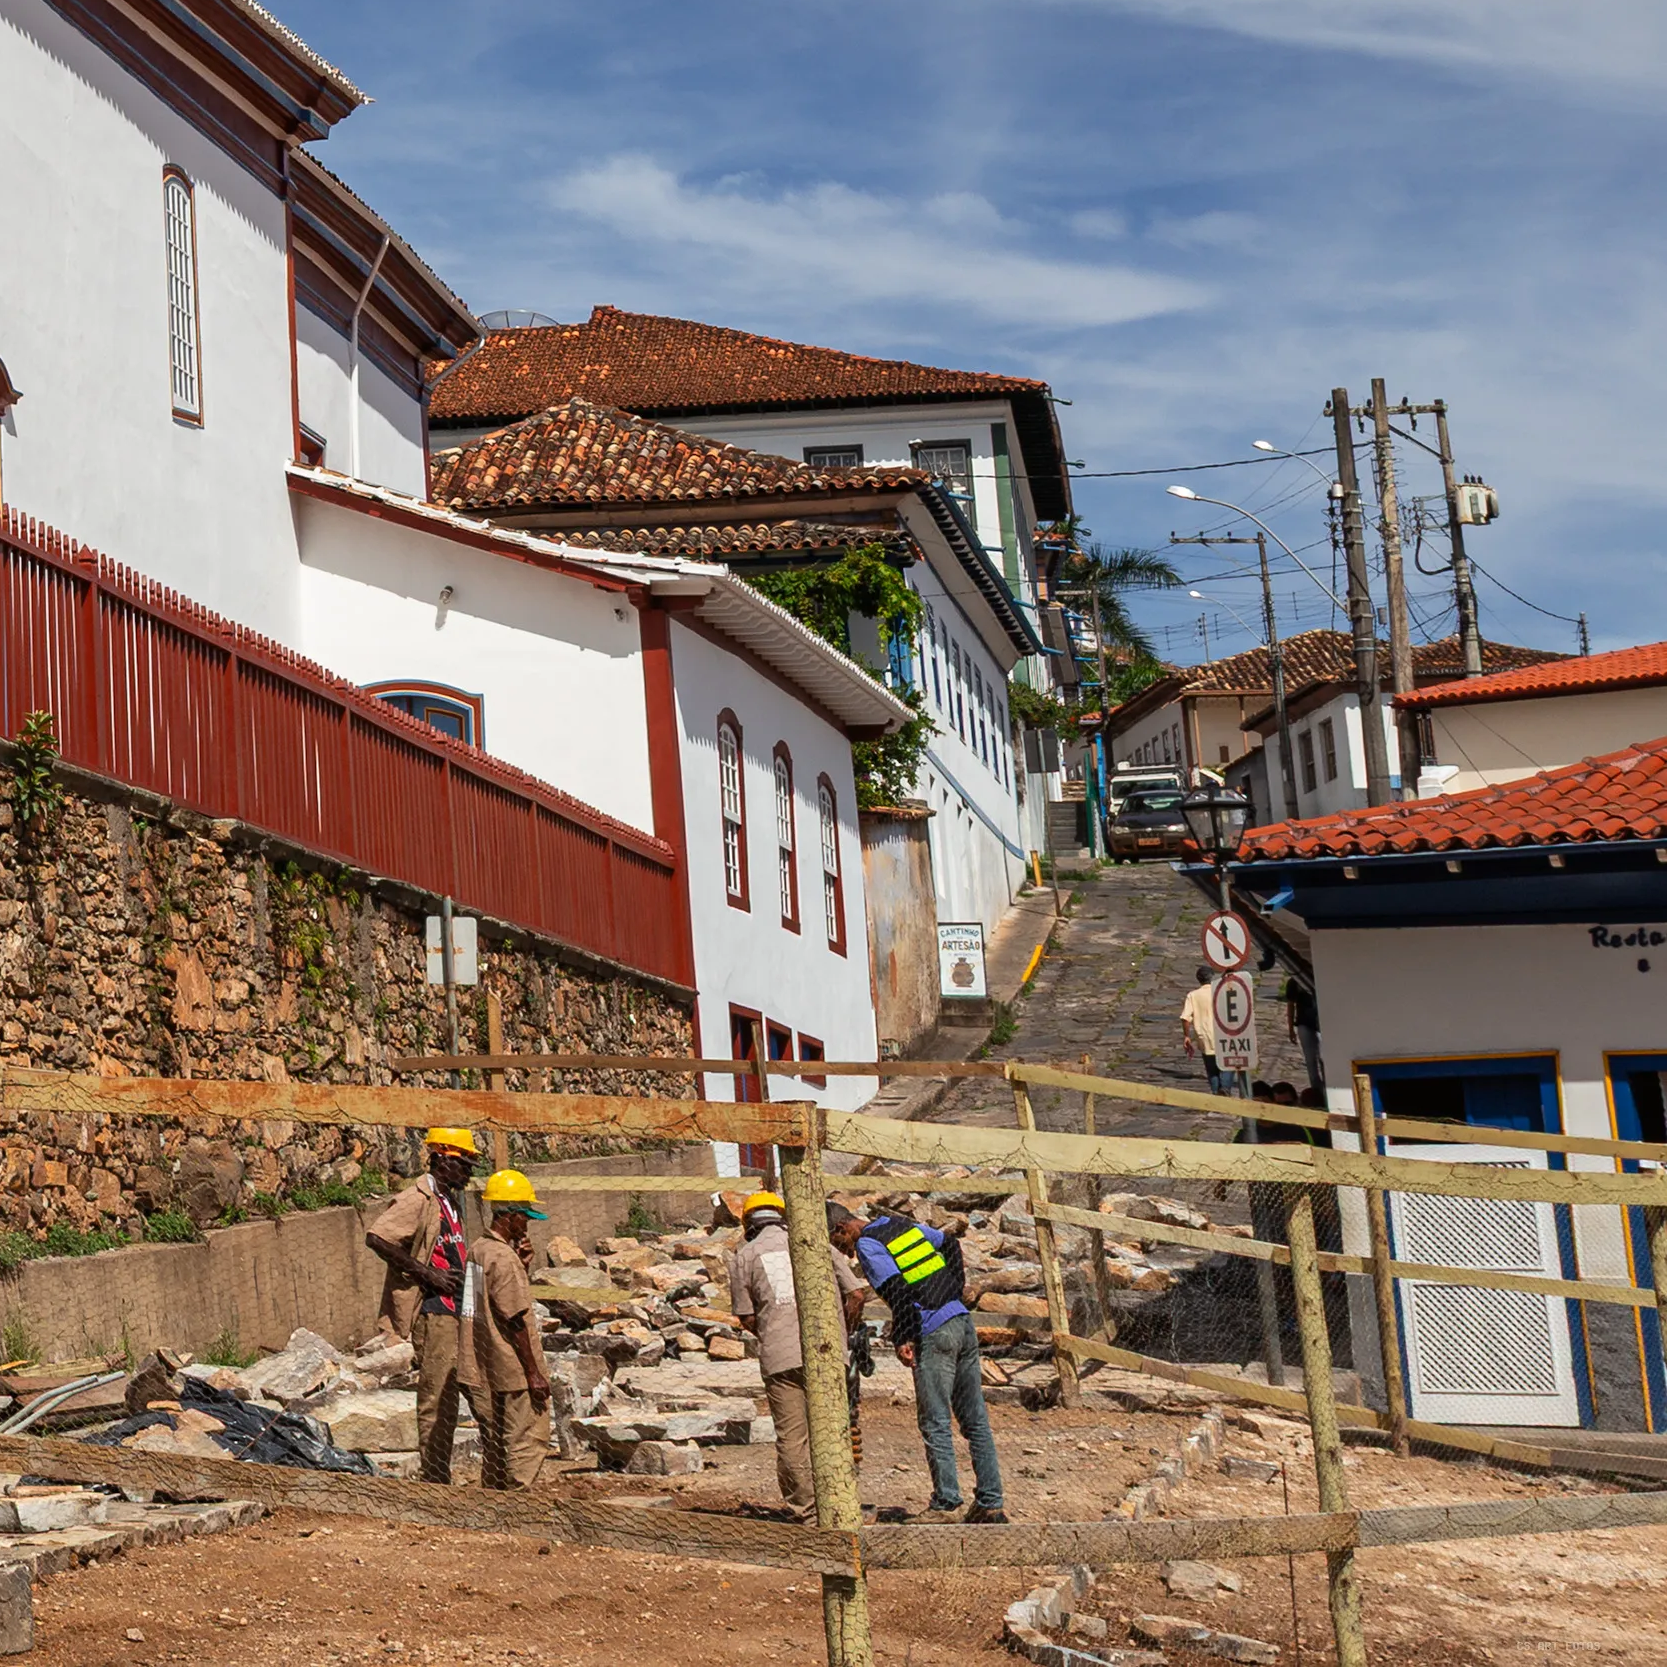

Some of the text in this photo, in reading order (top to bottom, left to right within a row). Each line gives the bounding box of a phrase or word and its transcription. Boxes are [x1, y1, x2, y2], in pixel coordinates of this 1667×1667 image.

[941, 938, 980, 951] ARTESÃO
[1226, 989, 1238, 1022] E
[1219, 1038, 1251, 1052] TAXI
